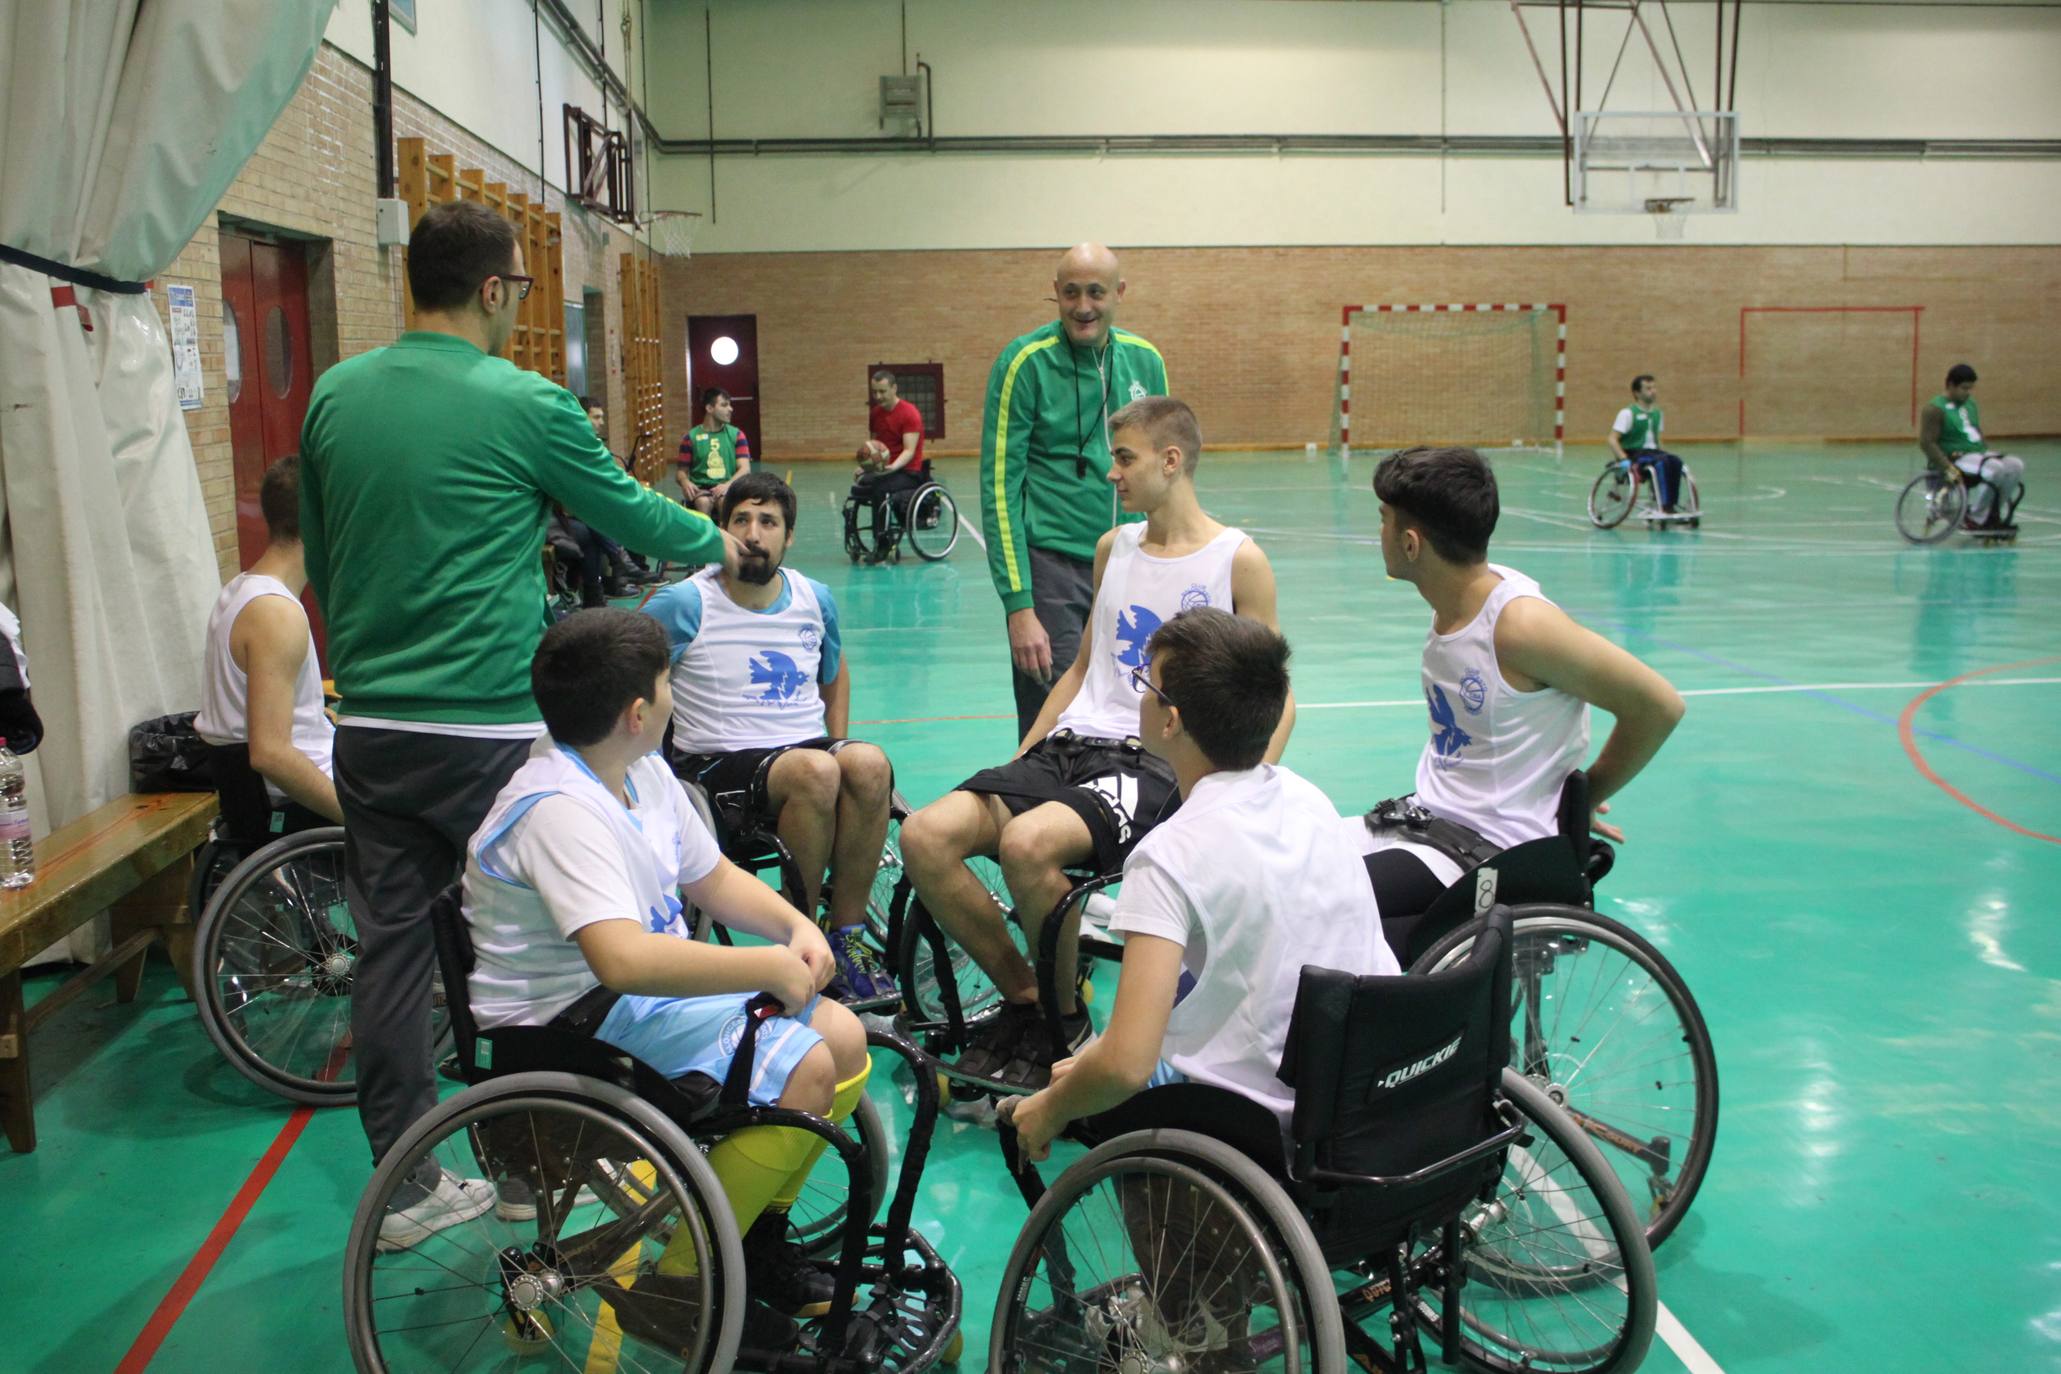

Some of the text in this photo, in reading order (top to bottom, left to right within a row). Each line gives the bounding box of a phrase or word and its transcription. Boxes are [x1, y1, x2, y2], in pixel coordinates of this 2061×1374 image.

[710, 438, 720, 451] 5
[1479, 879, 1494, 909] 8
[1384, 1036, 1462, 1088] QUICKIE
